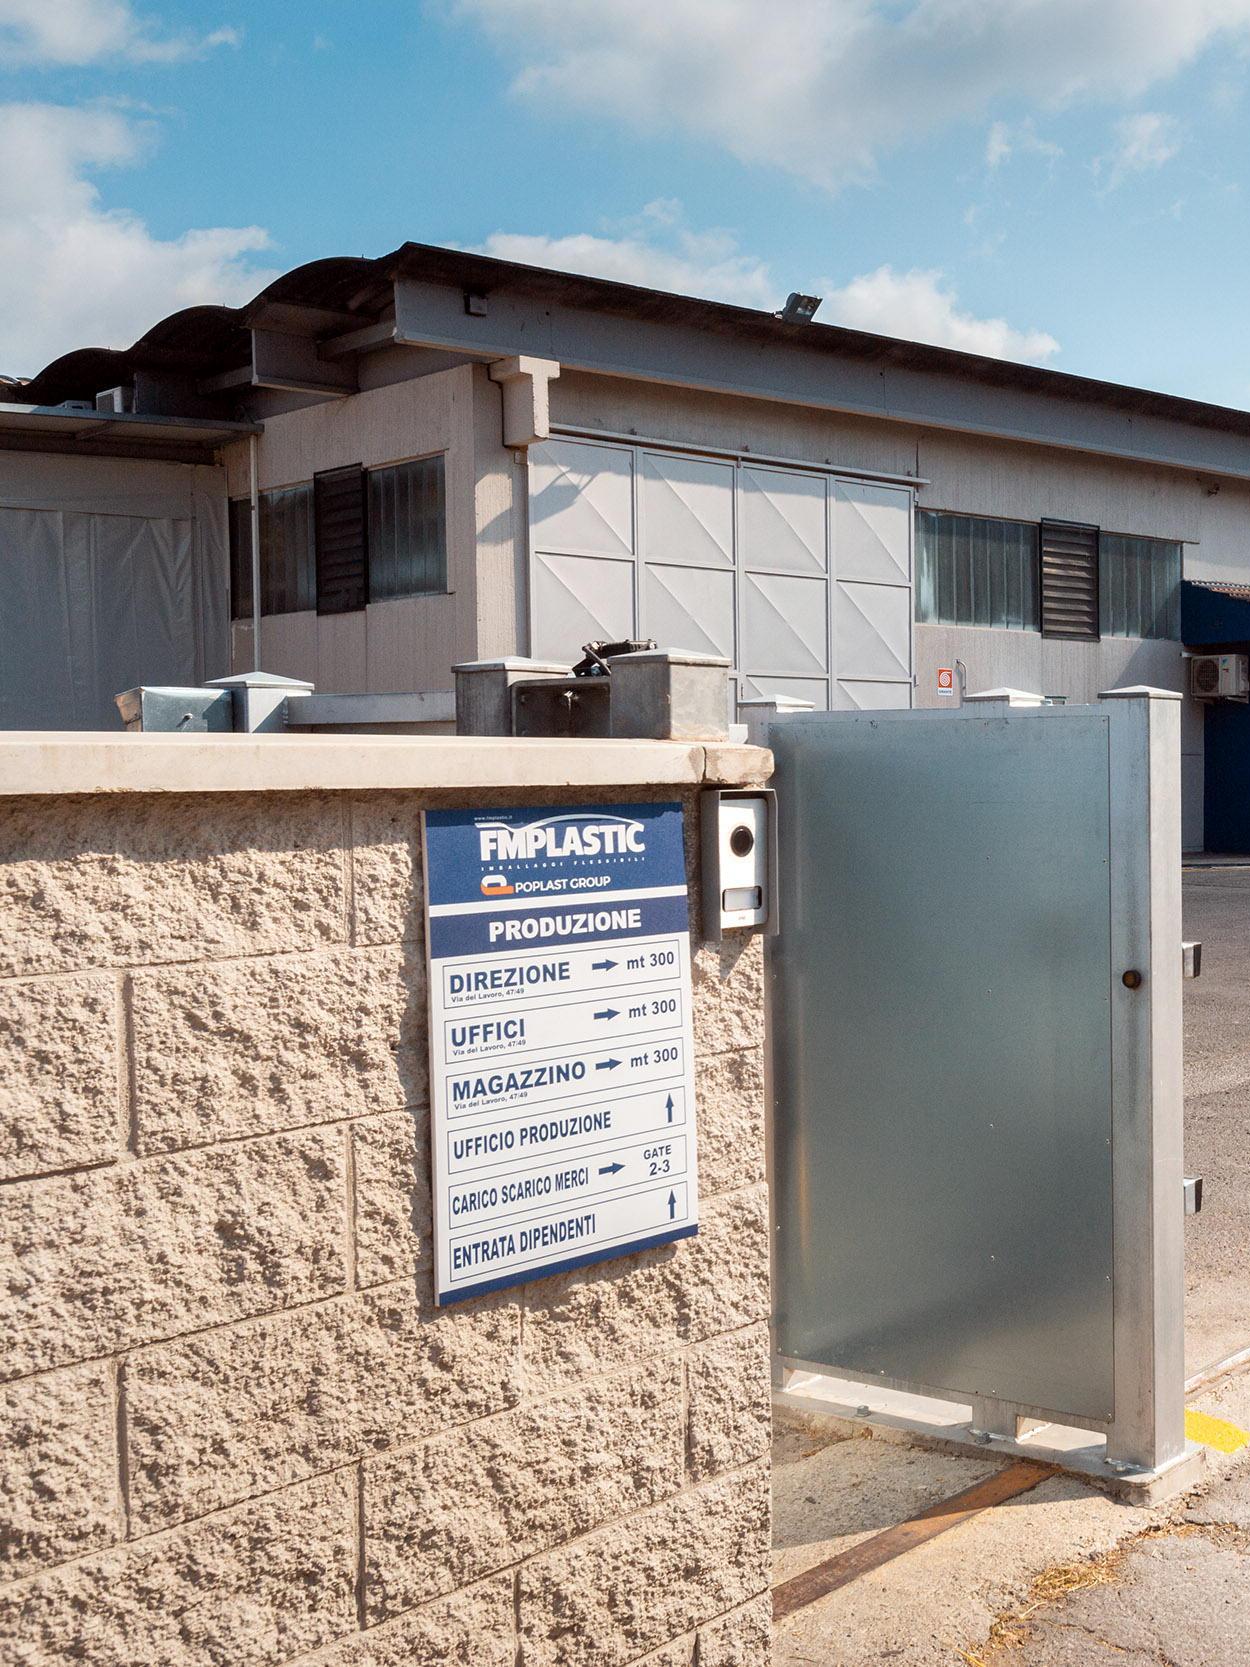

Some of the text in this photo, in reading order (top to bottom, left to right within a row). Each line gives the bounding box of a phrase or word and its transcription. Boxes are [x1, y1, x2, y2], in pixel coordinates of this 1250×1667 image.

[479, 823, 645, 861] FMPLASTIC
[481, 861, 564, 871] IMBALLAGGI
[515, 876, 611, 893] POPLAST GROUP
[489, 908, 642, 943] PRODUZIONE
[450, 951, 675, 994] DIREZIONE mt 300
[479, 991, 504, 999] Lavoro,
[451, 999, 676, 1047] UFFICI mt 300
[480, 1044, 506, 1052] Lavoro,
[452, 1047, 678, 1101] MAGAZZINO mt 300
[482, 1097, 508, 1105] Lavoro,
[454, 1111, 612, 1160] UFFICIO PRODUZIONE
[643, 1145, 672, 1160] GATE
[649, 1159, 671, 1176] 2-3
[452, 1167, 589, 1215] CARICO SCARICO MERCI
[454, 1213, 596, 1270] ENTRATA DIPENDENTI
